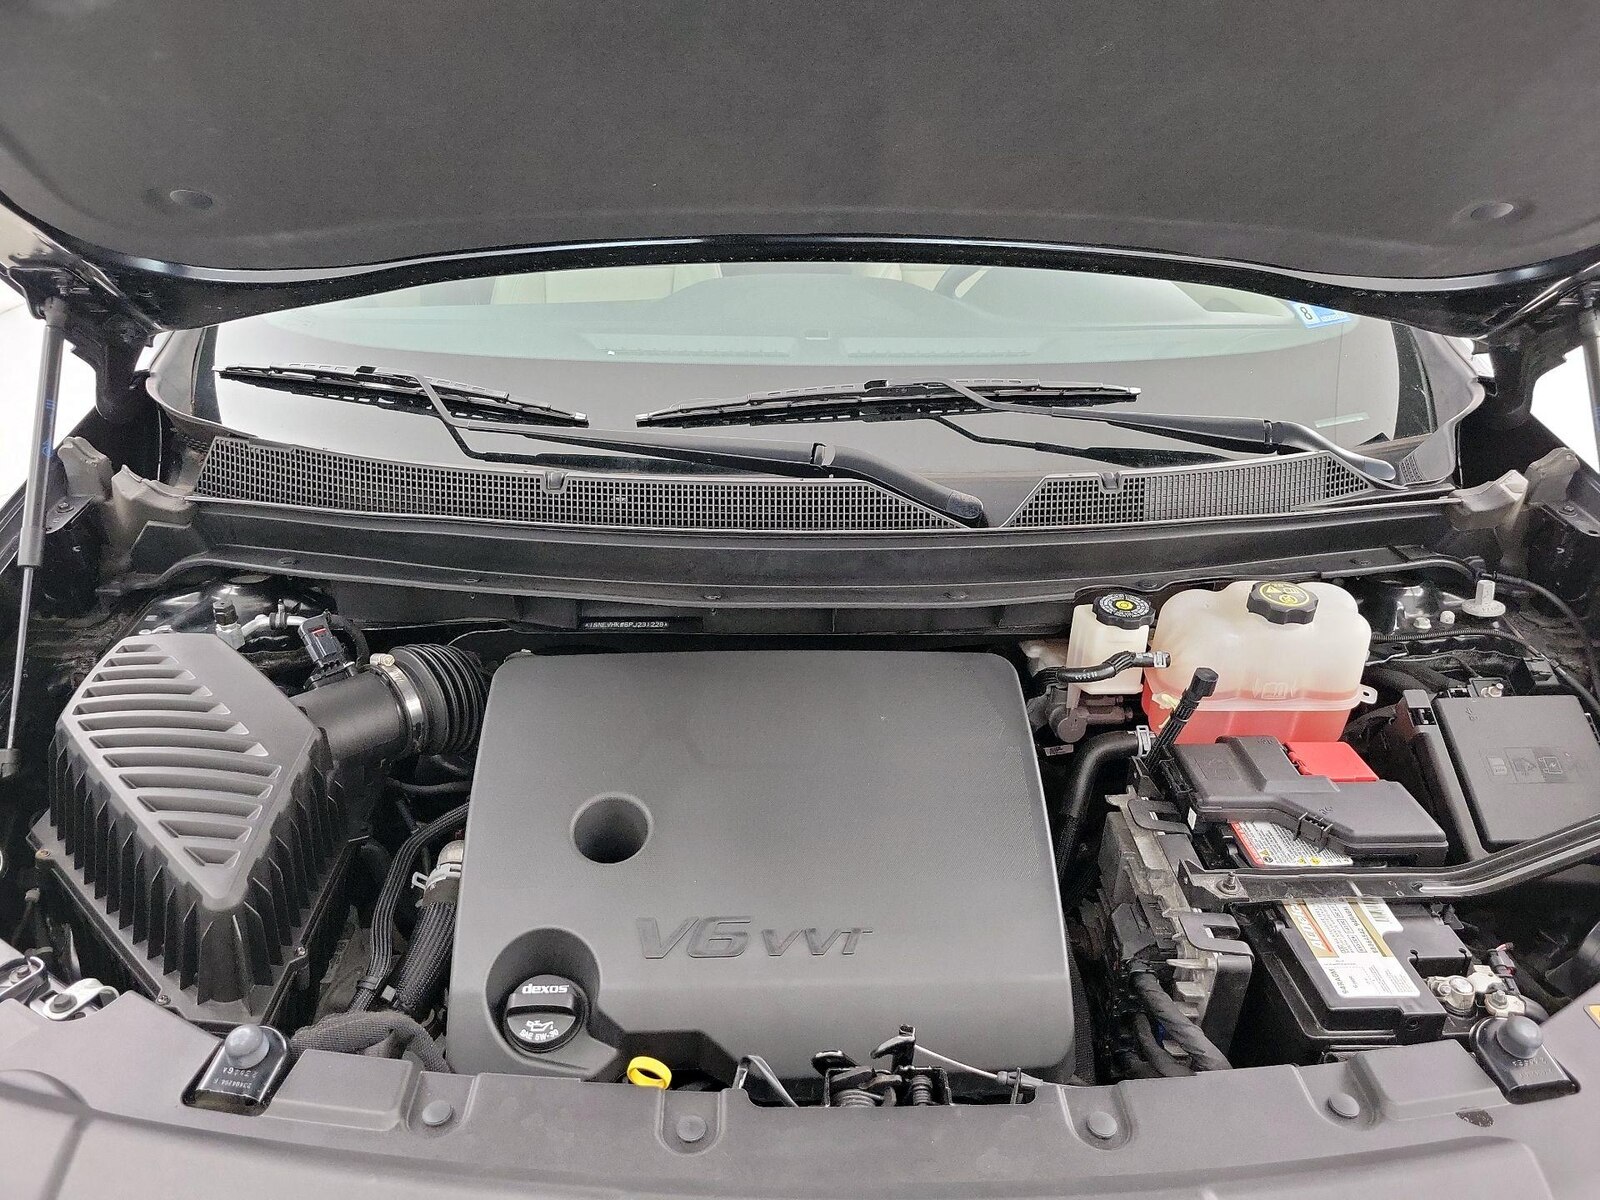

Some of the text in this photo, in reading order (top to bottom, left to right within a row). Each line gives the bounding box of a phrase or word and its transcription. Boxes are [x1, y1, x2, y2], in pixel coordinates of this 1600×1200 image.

[1300, 306, 1313, 320] 8
[637, 915, 874, 959] V6 VVT
[521, 983, 570, 994] dexos
